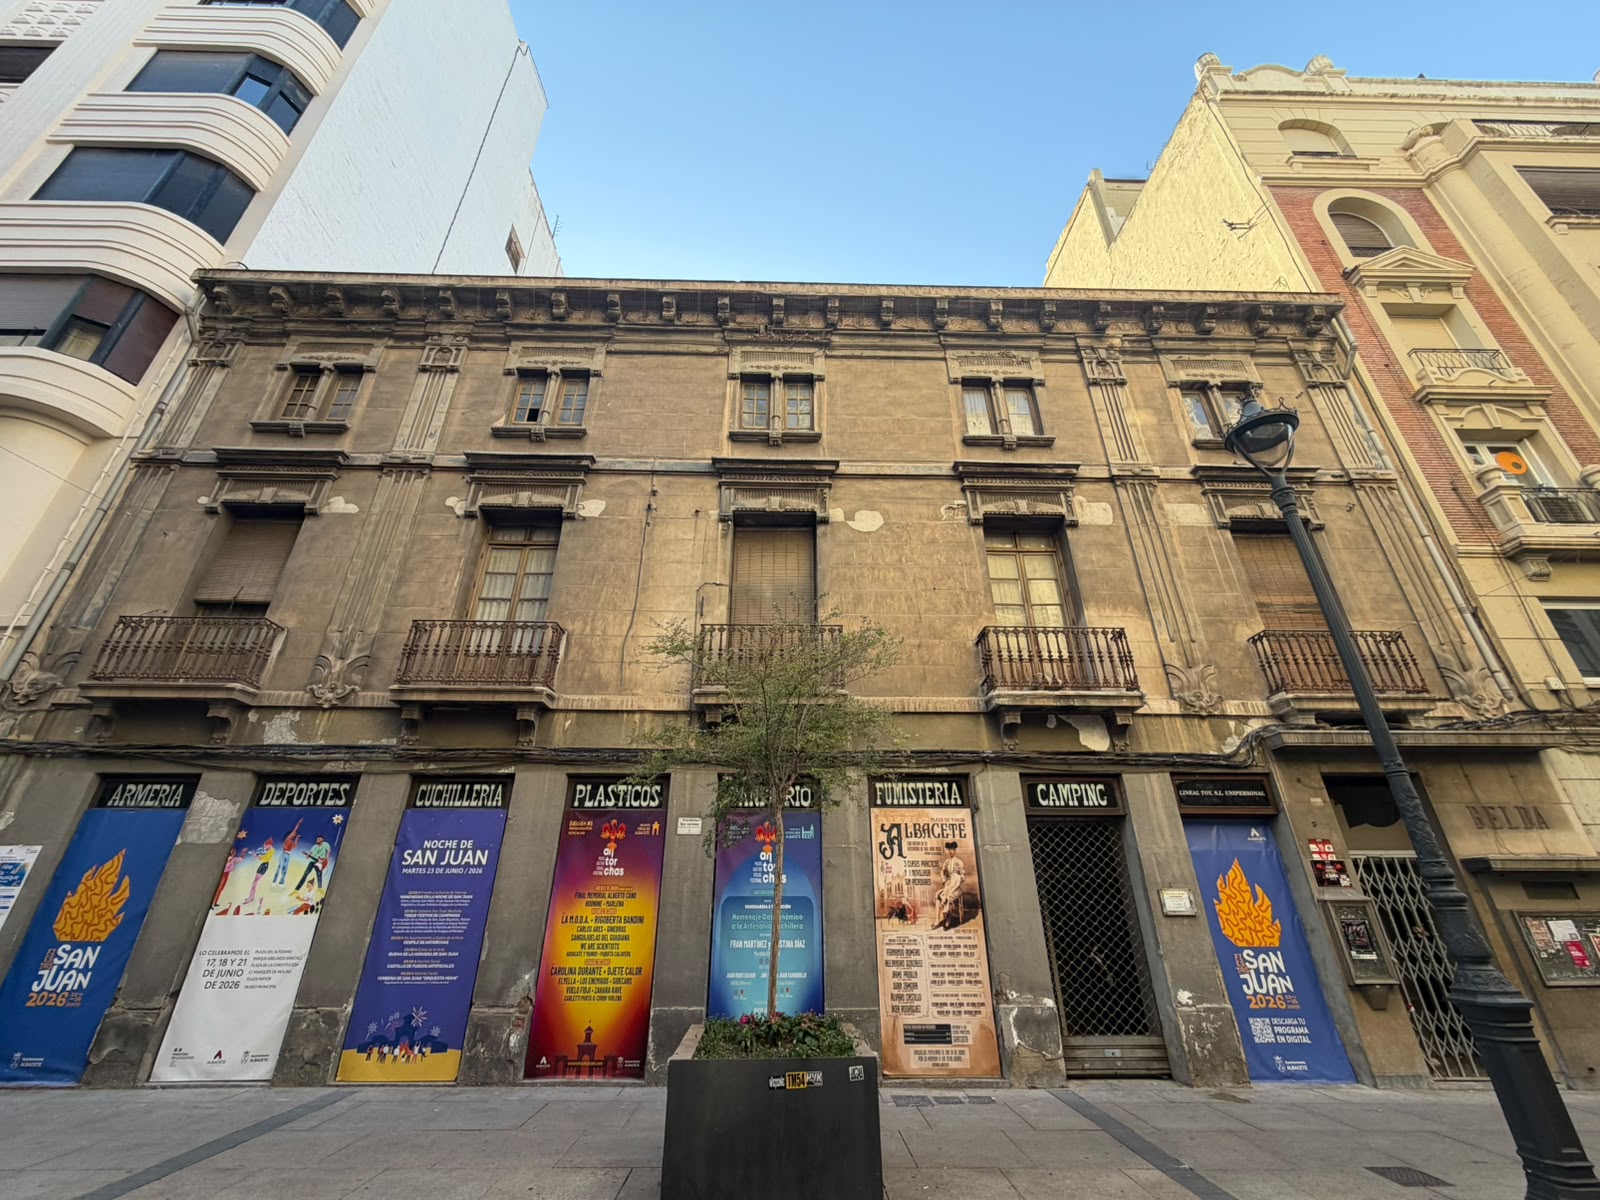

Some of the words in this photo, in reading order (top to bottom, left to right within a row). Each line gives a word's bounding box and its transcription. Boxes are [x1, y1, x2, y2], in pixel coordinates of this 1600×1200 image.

[108, 783, 184, 807] ARMERIA
[260, 782, 350, 806] DEPORTES
[416, 784, 502, 807] CUCHILLERIA
[574, 784, 660, 807] PLASTICOS
[875, 782, 962, 805] FUMISTERIA
[1037, 784, 1107, 806] CAMPING
[1465, 806, 1551, 829] BELDA
[423, 840, 458, 848] NOCHE
[460, 840, 473, 848] DE
[879, 823, 966, 860] ALBACETE
[402, 850, 437, 866] SAN
[440, 850, 488, 866] JUAN
[605, 857, 618, 866] tor
[604, 867, 624, 876] chas
[763, 873, 787, 883] chs
[561, 916, 568, 924] LA
[594, 916, 622, 924] RIGOBERTA
[624, 916, 644, 924] BANDINI
[730, 940, 742, 948] FRAN
[744, 938, 767, 948] MARTÍNEZ
[795, 938, 805, 948] DÍAZ
[54, 944, 101, 969] SAN
[206, 959, 216, 968] 17,
[1243, 949, 1286, 973] SAN
[32, 966, 92, 992] JUAN
[202, 969, 215, 977] DE
[216, 969, 244, 978] JUNIO
[551, 967, 576, 976] CAROLINA
[578, 967, 602, 976] DURANTE
[607, 967, 624, 976] OJETE
[625, 967, 642, 976] CALOR
[204, 981, 217, 989] DE
[219, 981, 240, 989] 2026
[1240, 970, 1294, 995] JUAN
[25, 992, 69, 1007] 2026
[1247, 994, 1286, 1009] 2026
